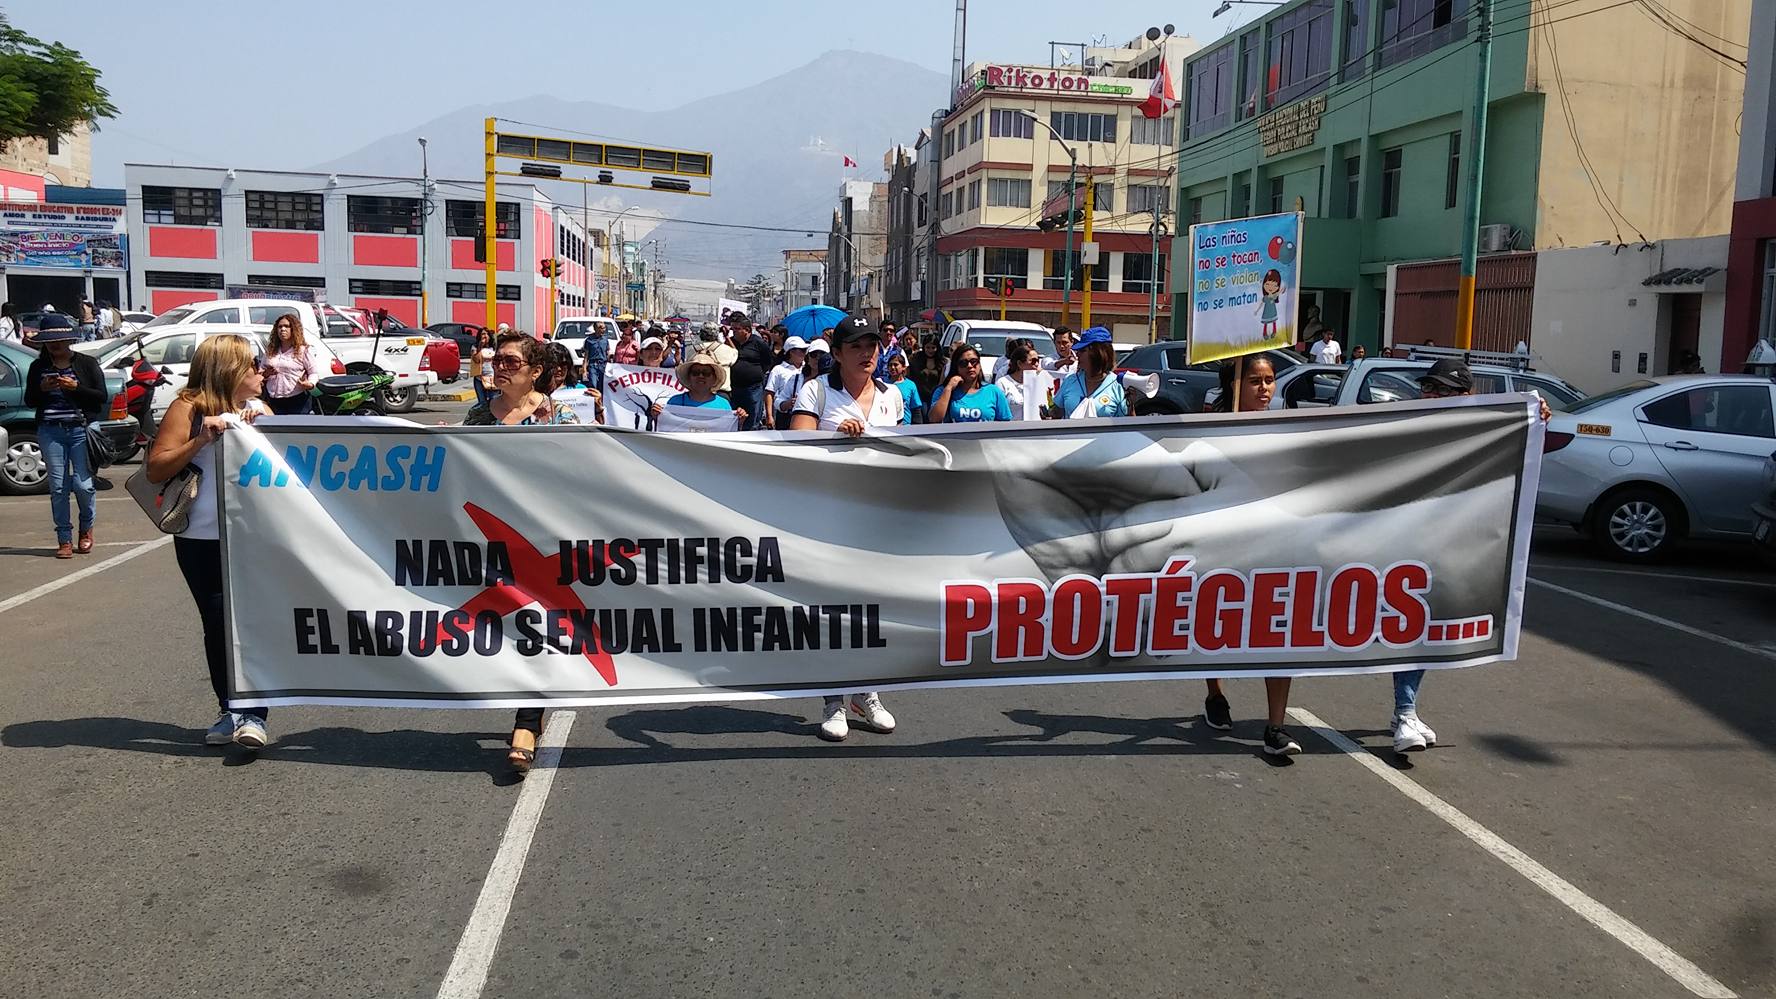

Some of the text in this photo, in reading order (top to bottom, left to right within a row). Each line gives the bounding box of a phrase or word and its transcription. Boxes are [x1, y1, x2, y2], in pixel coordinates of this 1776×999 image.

[987, 65, 1090, 91] Rikoton
[75, 215, 117, 223] SABIDURIA
[20, 232, 85, 243] BIENVENIDOS
[1199, 229, 1248, 250] Las niñas
[1198, 250, 1264, 270] no se tocan,
[1198, 278, 1210, 292] no
[1214, 276, 1226, 289] se
[1197, 291, 1258, 313] no se matan
[384, 345, 409, 354] 4x4
[960, 407, 981, 419] NO
[238, 444, 447, 493] ANCASH
[394, 536, 785, 587] NADA JUSTIFICA
[293, 603, 888, 657] EL ABUSO SEXUAL INFANTIL
